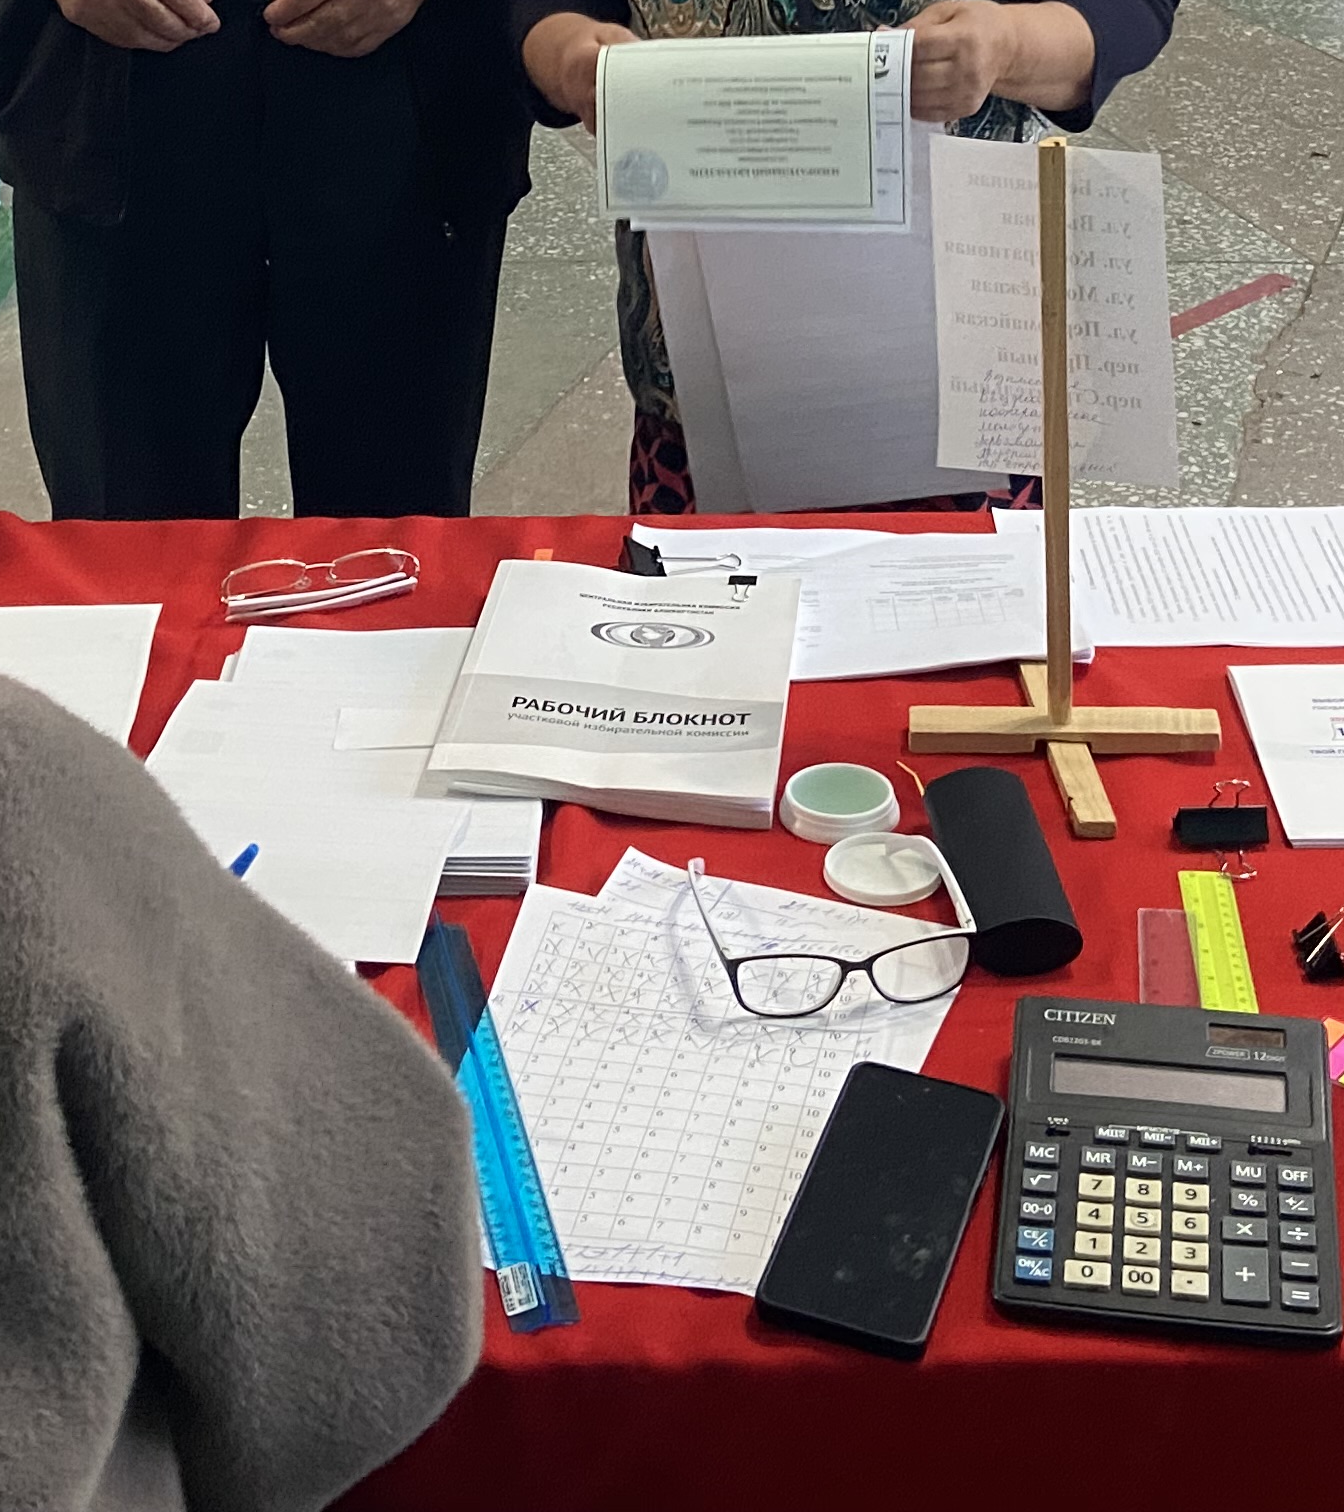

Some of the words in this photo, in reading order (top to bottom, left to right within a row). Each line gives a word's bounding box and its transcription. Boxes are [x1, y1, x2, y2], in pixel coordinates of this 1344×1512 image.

[511, 696, 626, 723] РАБОЧИЙ
[632, 711, 752, 727] БЛОКНОТ
[507, 711, 581, 728] участковой
[583, 722, 683, 737] избирательной
[686, 728, 750, 737] комиссии
[1043, 1008, 1117, 1026] CITIZEN
[801, 1129, 814, 1138] 10
[795, 1151, 808, 1159] 10
[1029, 1147, 1055, 1159] MC
[1085, 1152, 1111, 1164] MR
[789, 1171, 802, 1180] 10
[1235, 1165, 1262, 1178] MU
[1282, 1169, 1308, 1182] OFF
[1091, 1179, 1103, 1190] 7
[1137, 1183, 1150, 1196] 8
[1184, 1188, 1197, 1201] 9
[1087, 1208, 1100, 1220] 4
[1136, 1212, 1149, 1224] 5
[1184, 1217, 1197, 1229] 6
[1089, 1238, 1097, 1249] 1
[1135, 1242, 1148, 1254] 2
[1183, 1247, 1196, 1259] 3
[1081, 1266, 1094, 1278] 0
[1127, 1271, 1154, 1284] 00
